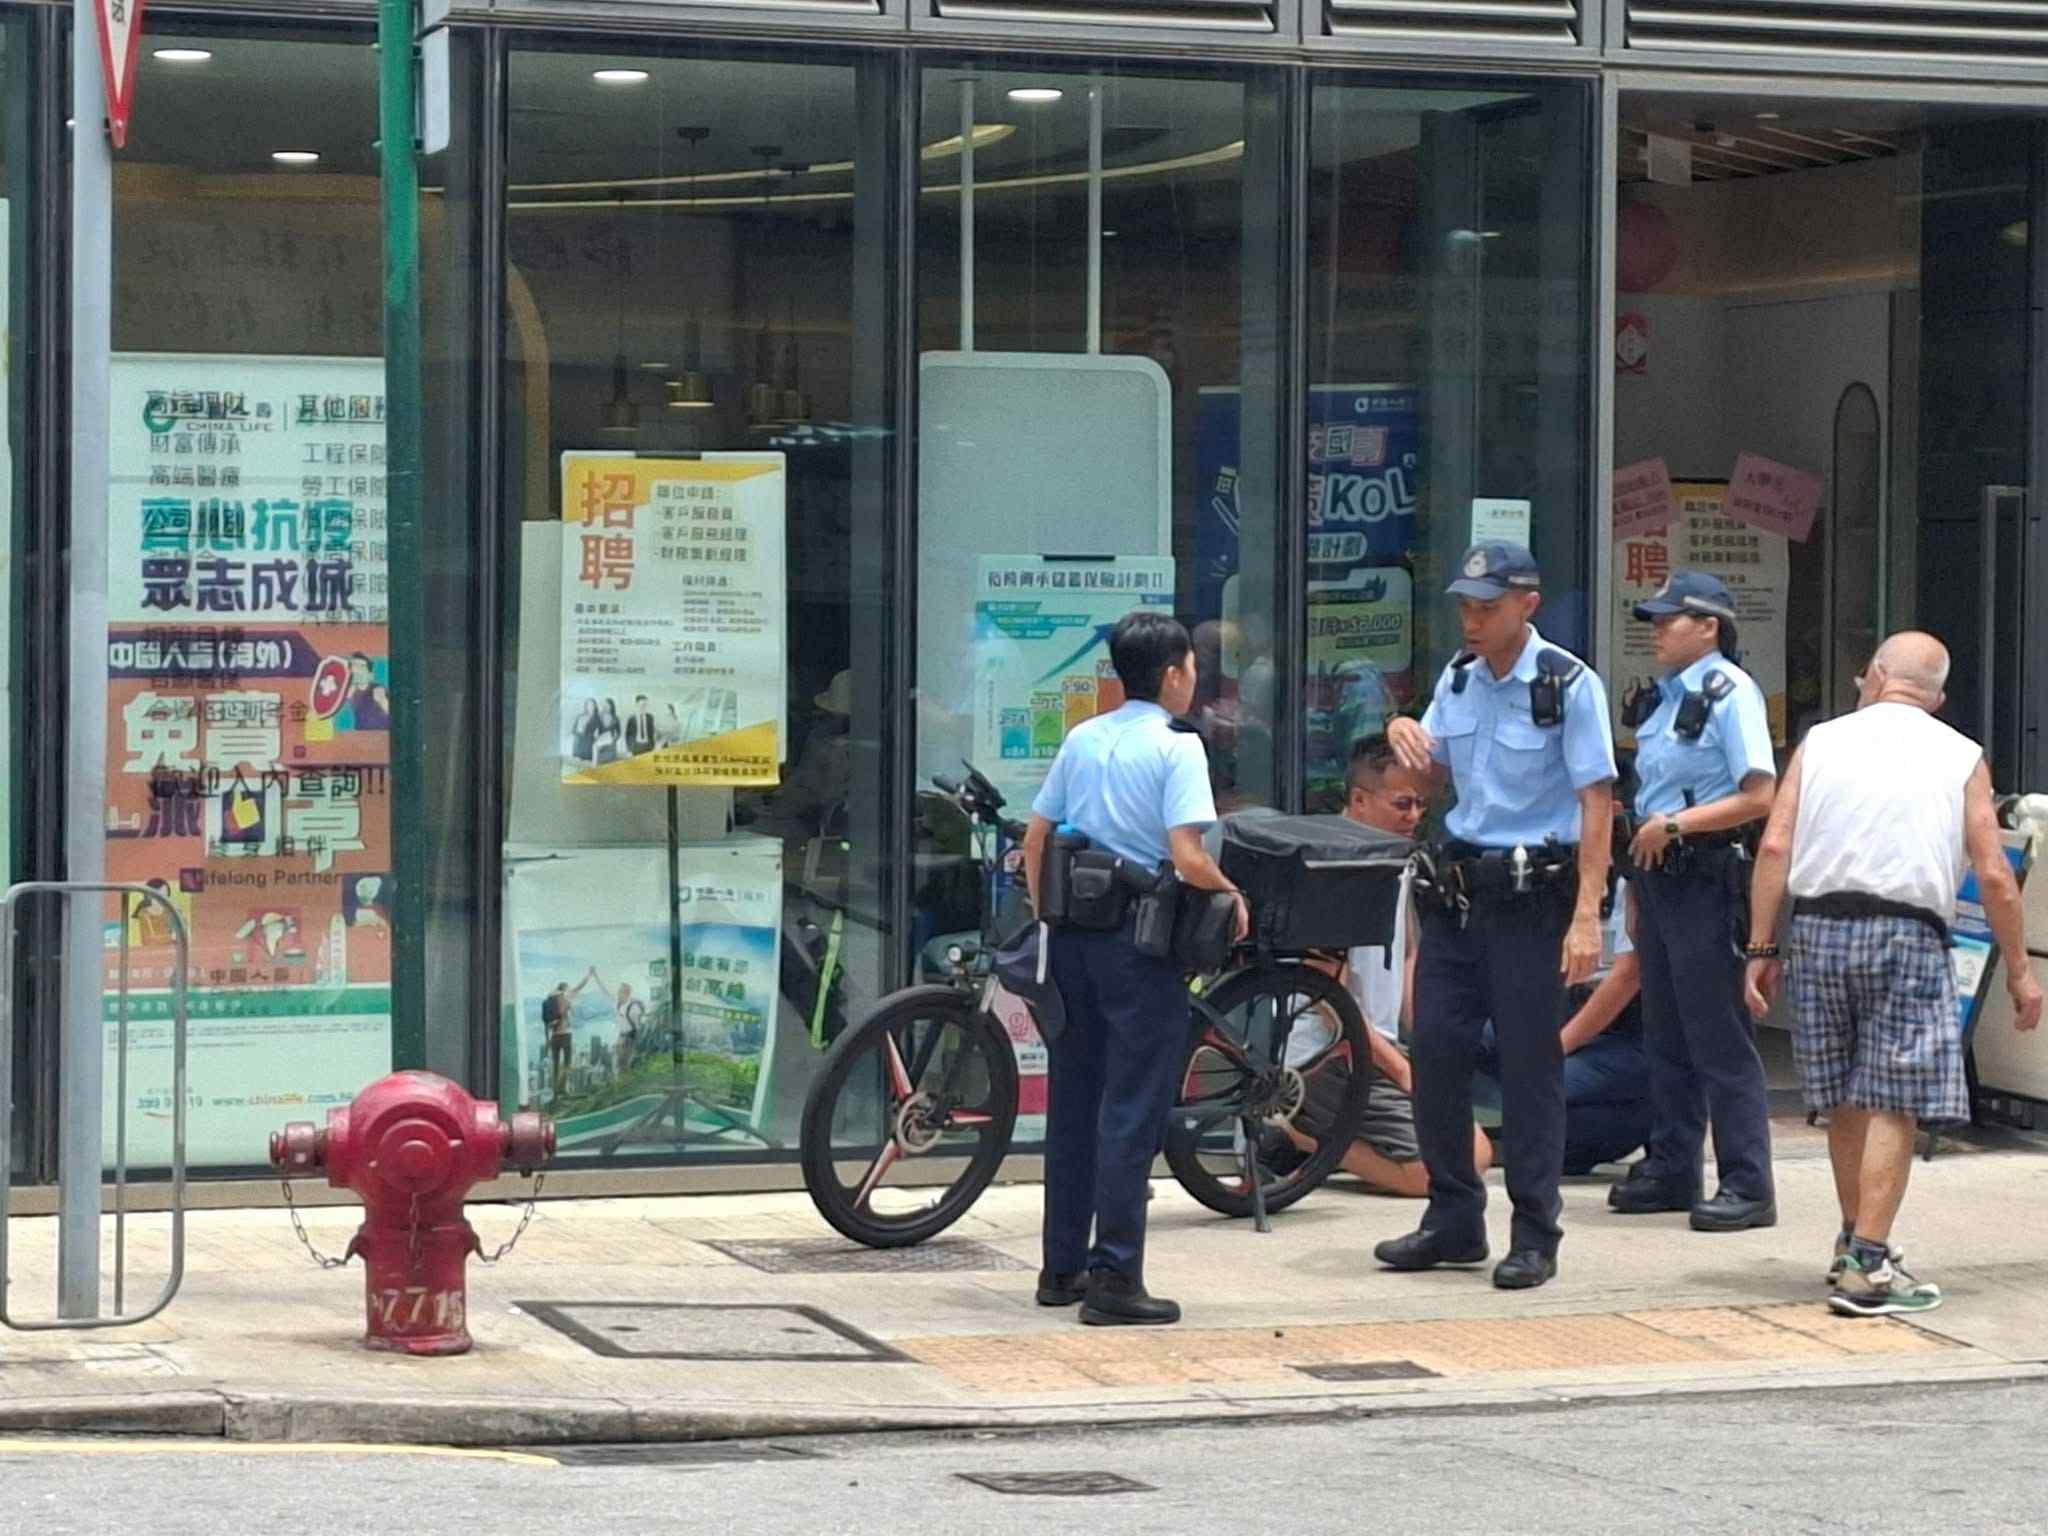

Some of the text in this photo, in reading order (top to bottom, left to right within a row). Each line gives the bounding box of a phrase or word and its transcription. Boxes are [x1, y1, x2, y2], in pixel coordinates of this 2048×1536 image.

[1325, 466, 1416, 520] KOL
[142, 498, 352, 551] 齊心抗疫
[580, 470, 636, 591] 招聘
[274, 869, 341, 886] Partner
